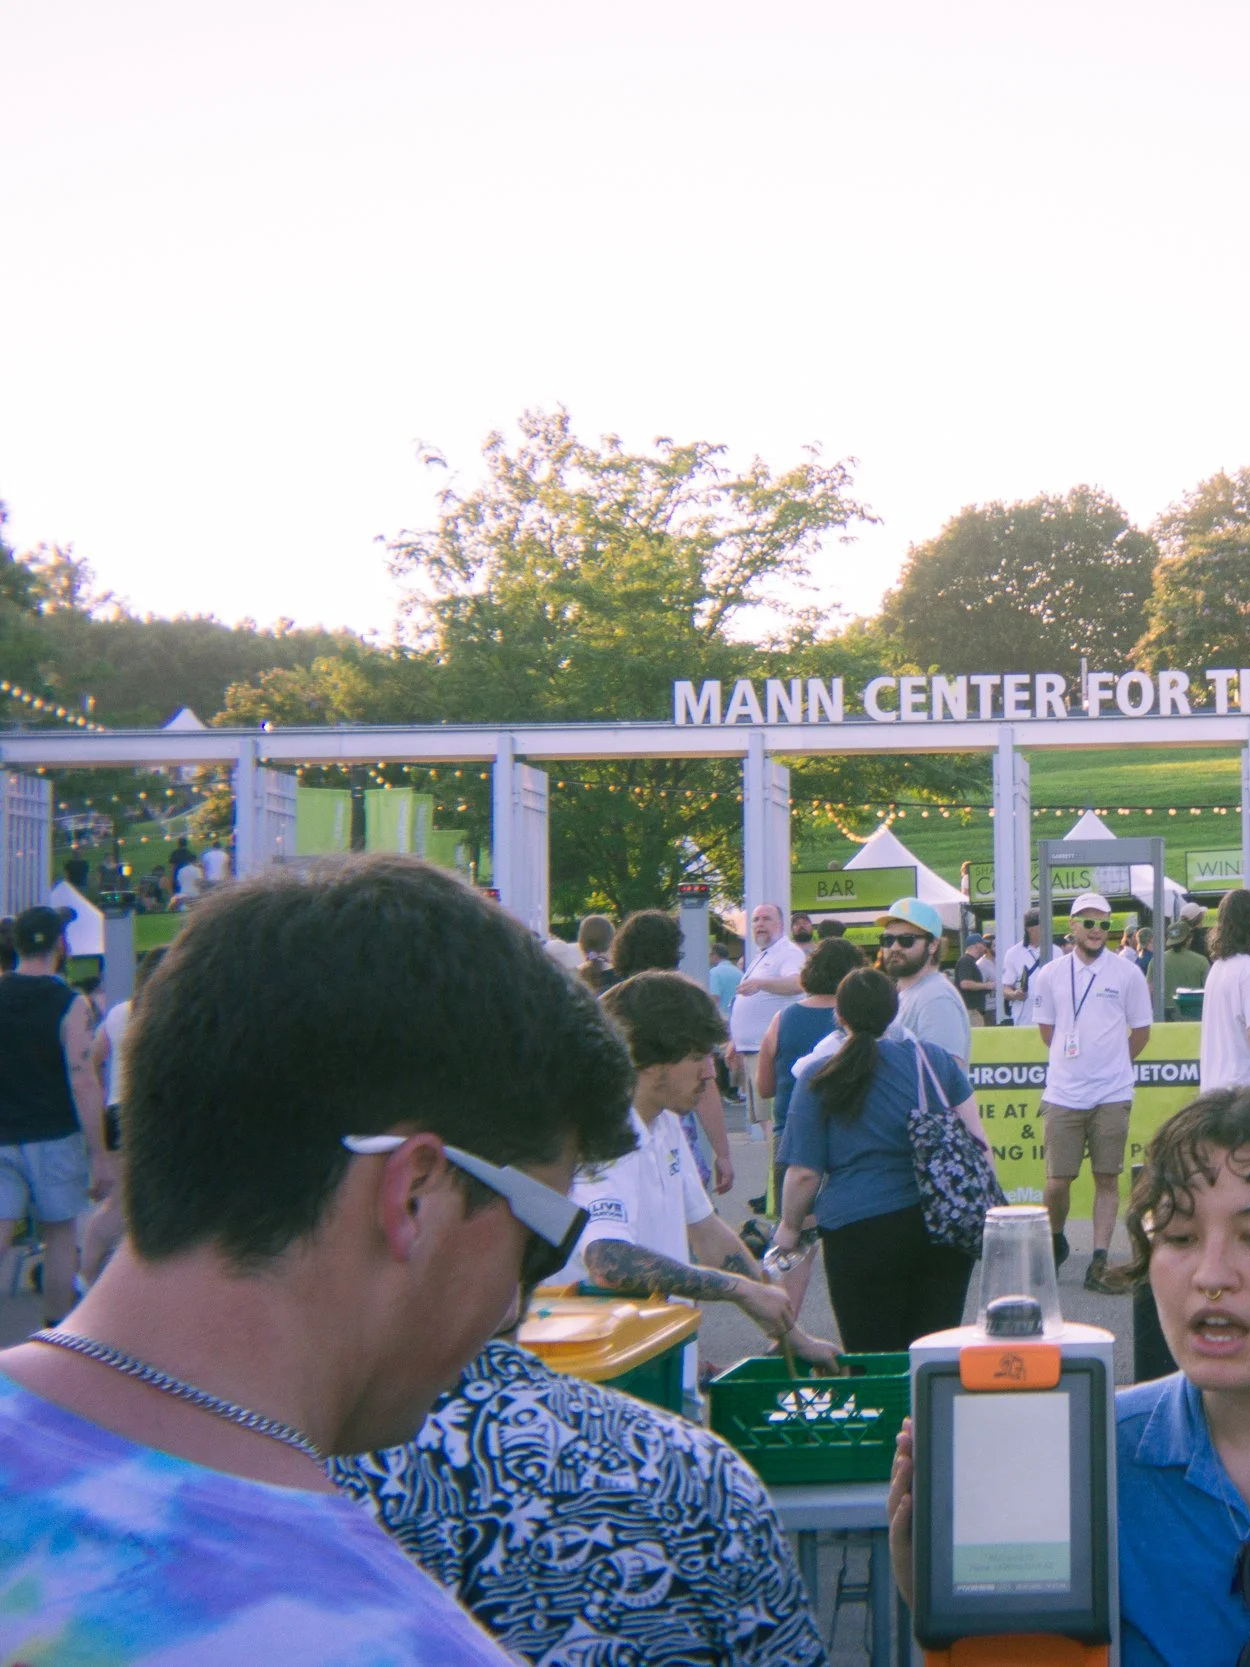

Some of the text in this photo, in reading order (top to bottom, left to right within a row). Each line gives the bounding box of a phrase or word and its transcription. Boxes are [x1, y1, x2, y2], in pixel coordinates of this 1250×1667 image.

[674, 677, 844, 725] MANN
[863, 672, 1068, 722] CENTER
[1087, 670, 1192, 717] FOR
[1196, 859, 1241, 877] WIN
[817, 879, 856, 898] BAR
[975, 869, 1091, 896] CKAILS
[967, 1066, 1049, 1085] HROUG
[1003, 1103, 1028, 1119] AT
[1021, 1123, 1035, 1139] &
